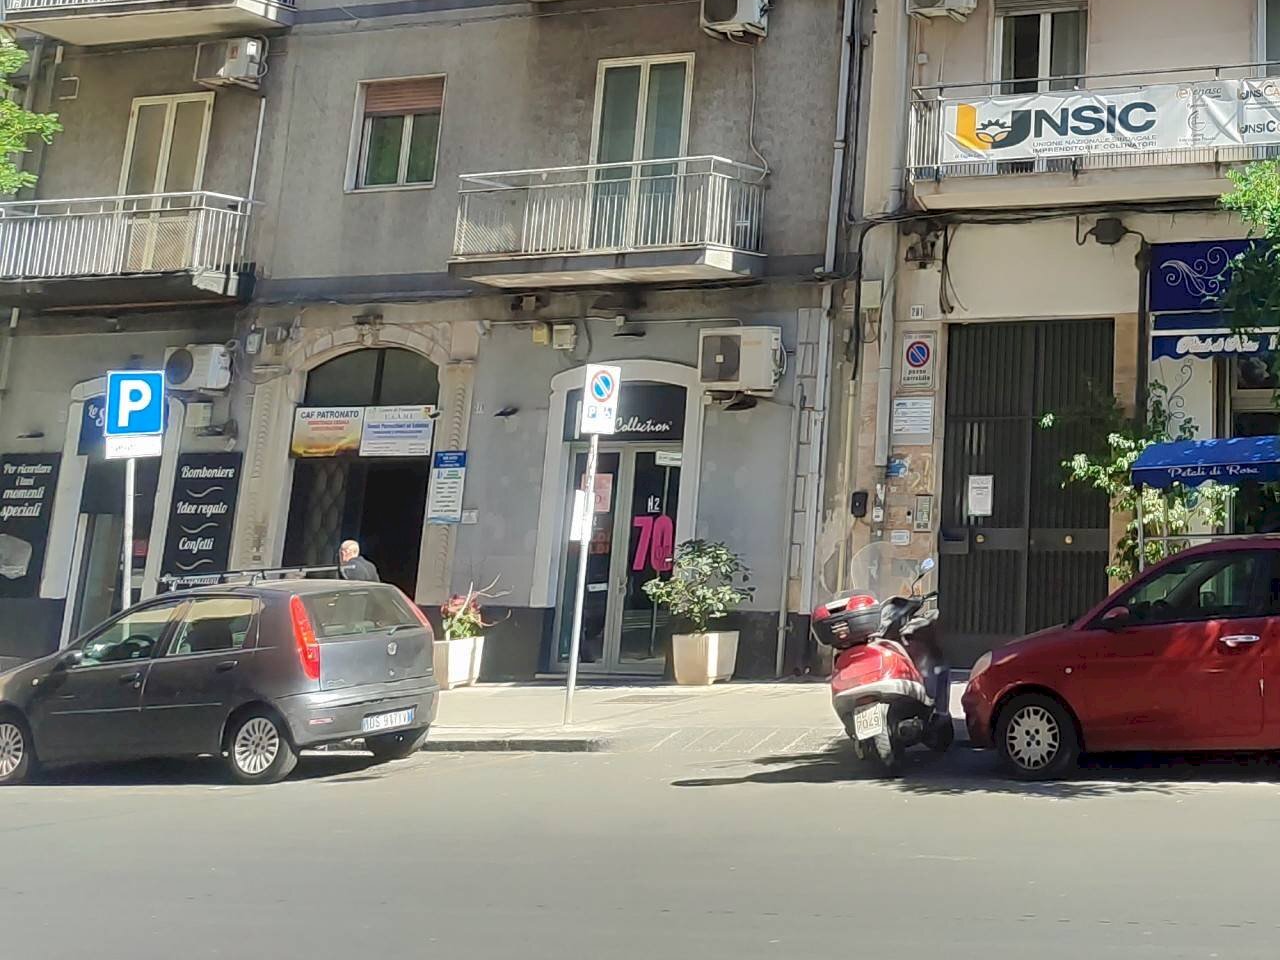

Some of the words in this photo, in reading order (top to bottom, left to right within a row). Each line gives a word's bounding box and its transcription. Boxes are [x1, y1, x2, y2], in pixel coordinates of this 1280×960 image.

[957, 101, 1157, 150] UNSIC
[1032, 139, 1063, 147] UNIONE
[1065, 137, 1109, 145] NAZIONALE
[118, 379, 151, 427] P
[301, 411, 316, 419] CAF
[317, 410, 359, 419] PATRONATO
[181, 465, 236, 478] Bomboniere
[0, 503, 42, 521] speciali
[176, 501, 196, 514] Idee
[197, 502, 228, 517] regalo
[178, 537, 215, 554] Confetti
